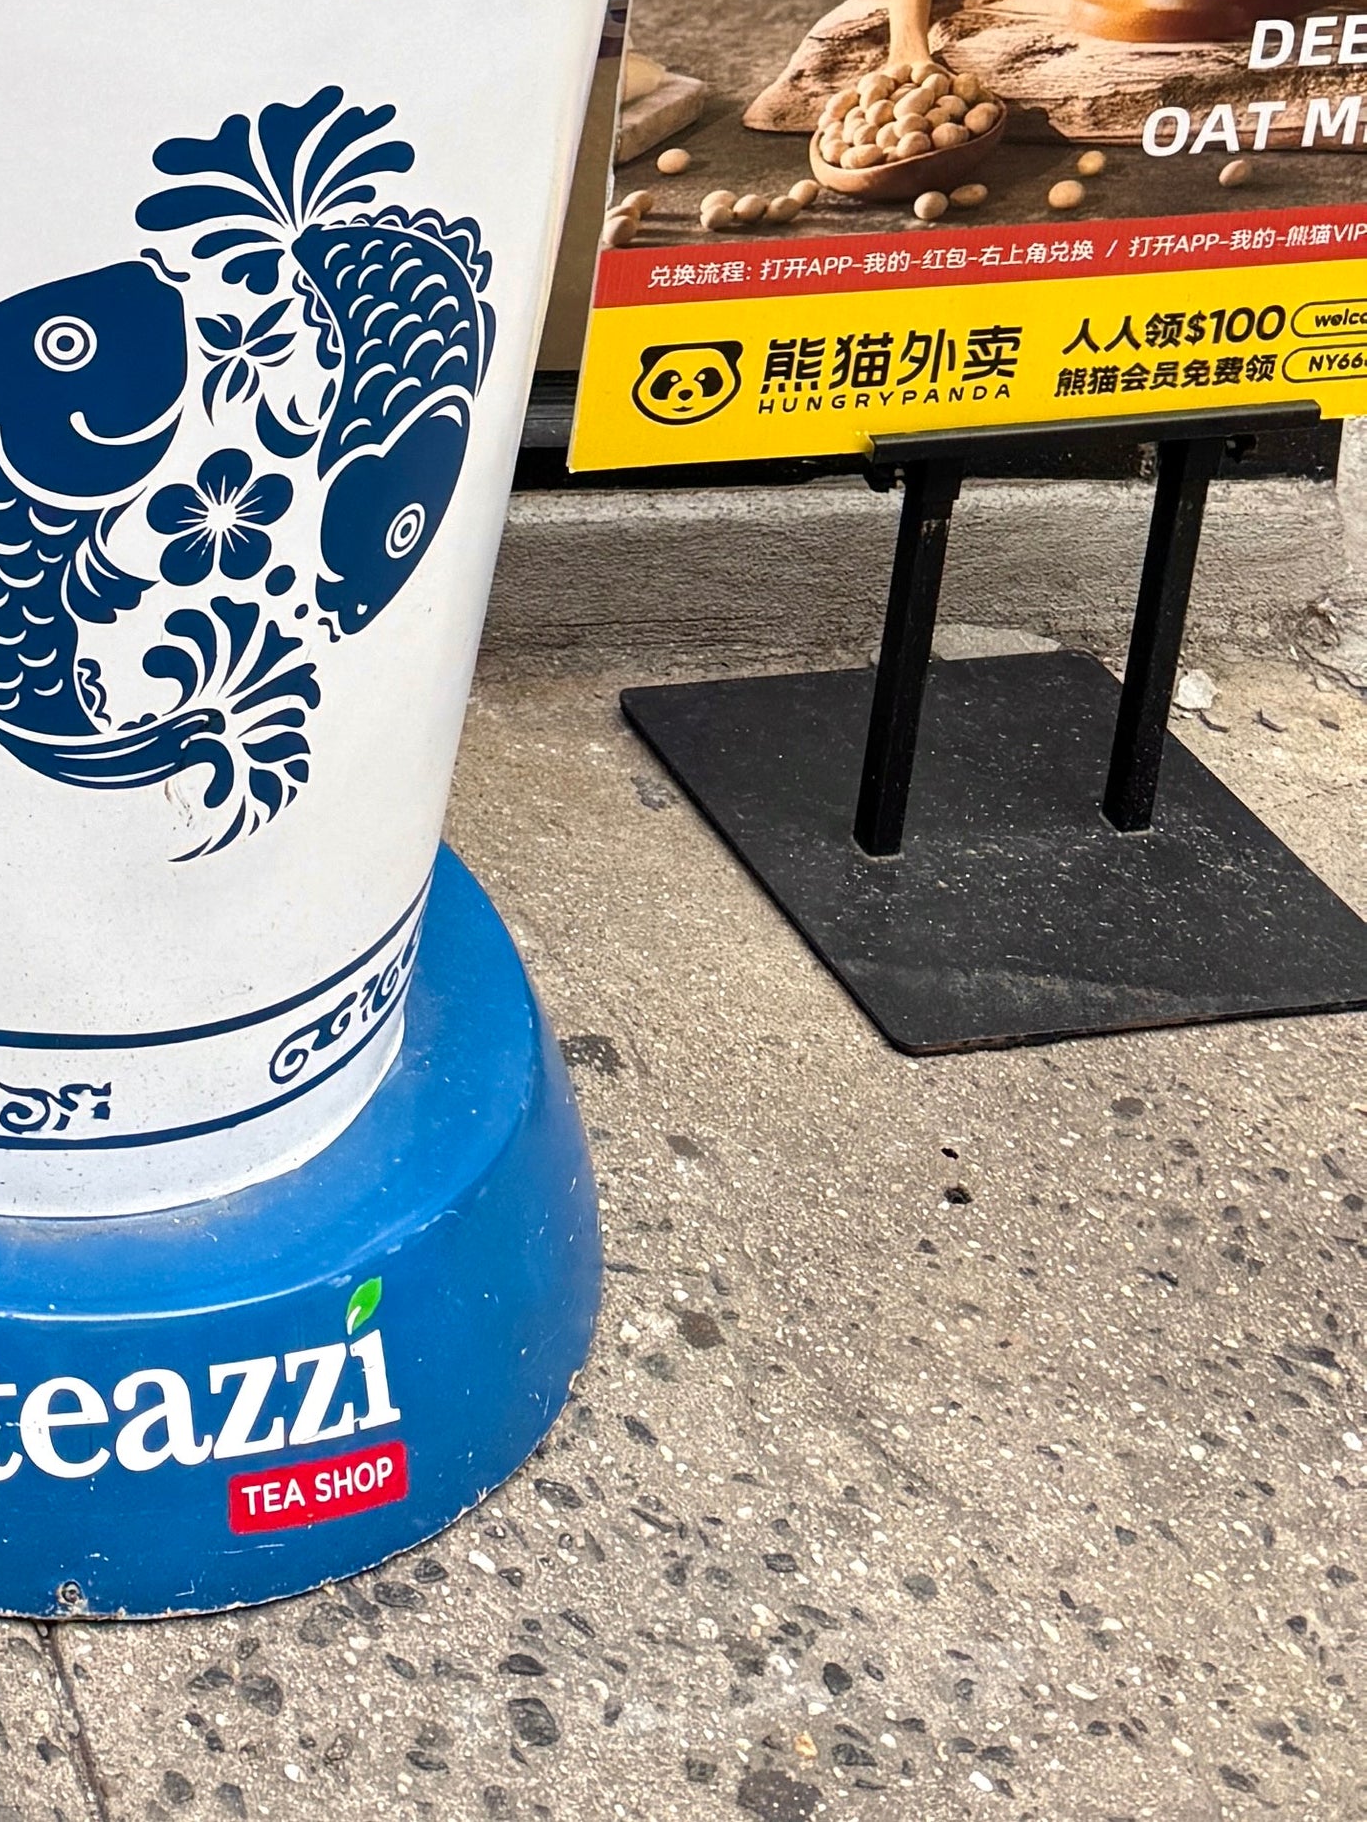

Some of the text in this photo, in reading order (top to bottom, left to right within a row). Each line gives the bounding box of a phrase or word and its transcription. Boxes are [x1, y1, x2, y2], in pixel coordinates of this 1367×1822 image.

[1248, 14, 1367, 70] DEE
[1141, 96, 1367, 157] OAT M
[1062, 305, 1285, 355] 人人领$100
[1315, 308, 1367, 327] welco
[760, 324, 1023, 395] 熊猫外卖
[1054, 354, 1278, 398] 熊猫会员免费领
[1309, 352, 1367, 372] NY66
[758, 383, 1011, 415] HUNGRYPANDA
[241, 1456, 393, 1516] TEA SHOP
